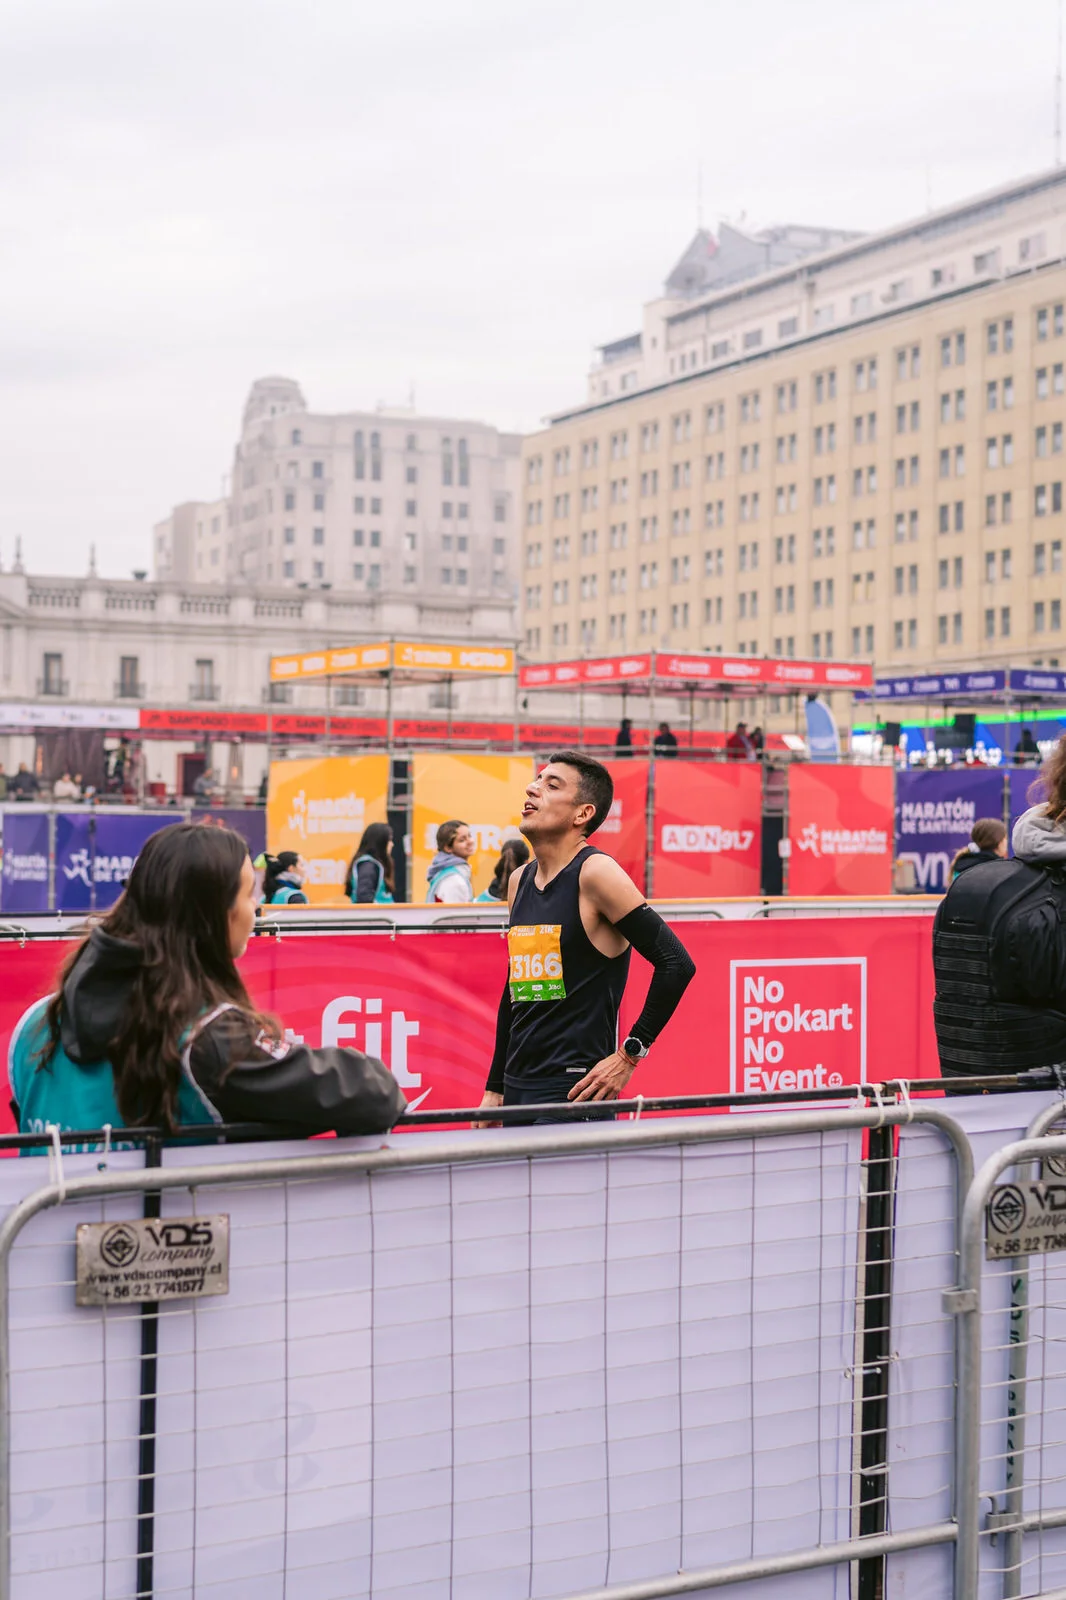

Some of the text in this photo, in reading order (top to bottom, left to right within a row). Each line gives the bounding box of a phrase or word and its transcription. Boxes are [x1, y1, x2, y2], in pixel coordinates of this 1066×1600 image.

[901, 797, 975, 819] MARATÓN
[821, 827, 887, 844] MARATÓN
[93, 855, 139, 869] MAR
[743, 976, 784, 1004] No
[743, 1003, 853, 1034] Prokart
[321, 995, 420, 1088] fit
[743, 1036, 784, 1064] No
[743, 1063, 827, 1092] Event
[145, 1222, 212, 1247] VDS
[140, 1247, 215, 1264] company
[133, 1283, 151, 1296] 22
[154, 1278, 204, 1294] 7741577
